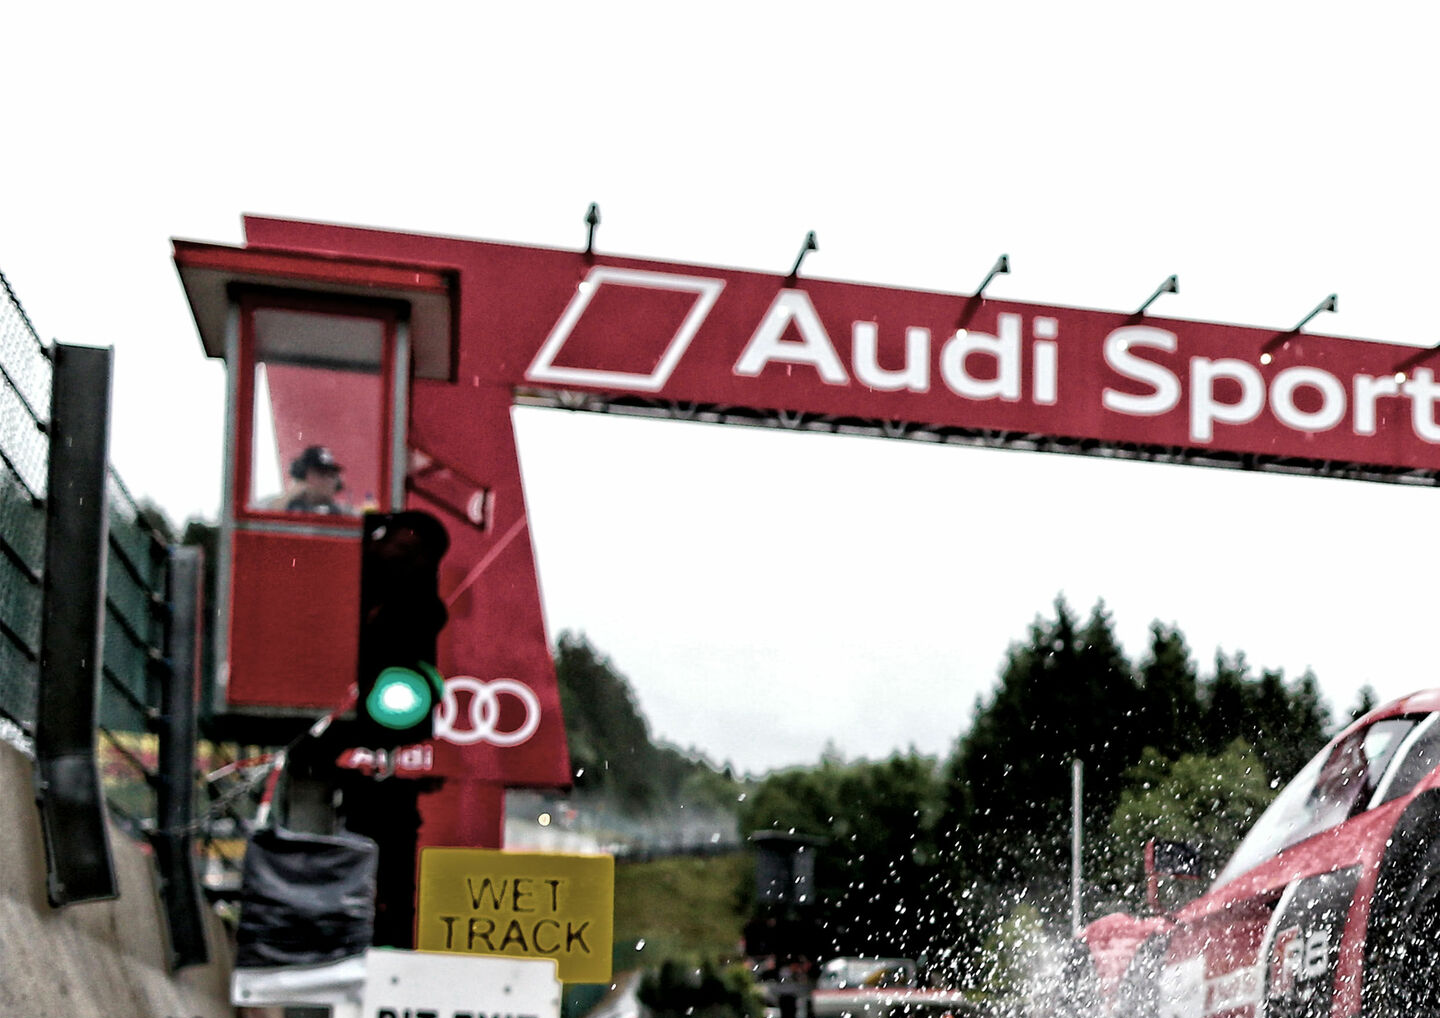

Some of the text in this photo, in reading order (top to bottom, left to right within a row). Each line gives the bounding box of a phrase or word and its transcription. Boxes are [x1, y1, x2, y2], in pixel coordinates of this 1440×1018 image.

[733, 288, 1058, 405] Audi
[467, 877, 565, 912] WET
[440, 916, 590, 954] TRACK
